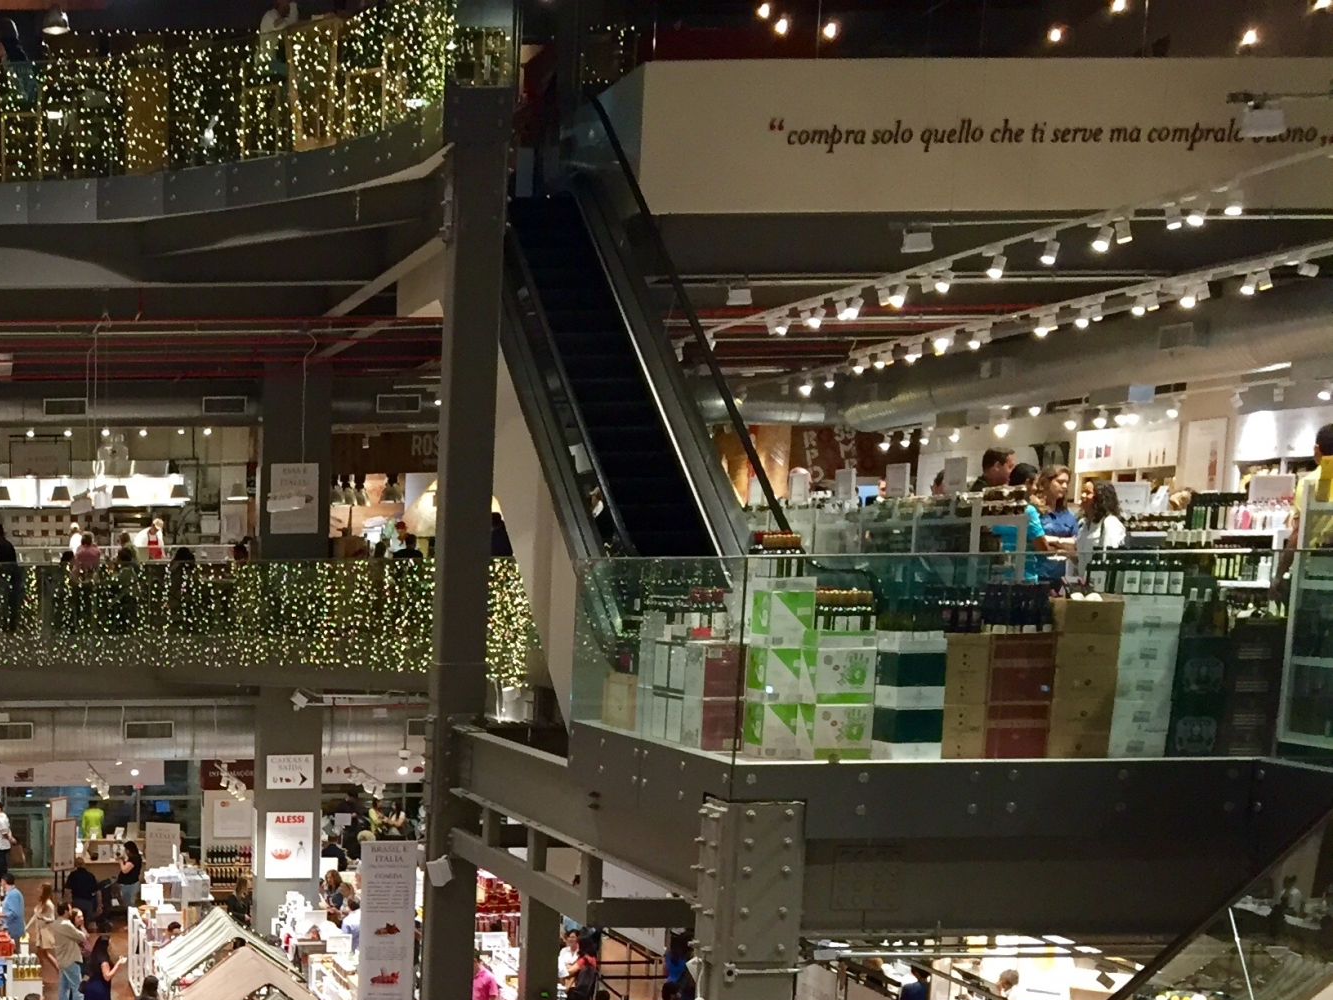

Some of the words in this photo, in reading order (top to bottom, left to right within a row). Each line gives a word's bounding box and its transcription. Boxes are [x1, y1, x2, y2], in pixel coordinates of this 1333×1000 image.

[870, 119, 914, 145] solo
[920, 118, 984, 153] quello
[989, 118, 1025, 144] che
[1031, 121, 1047, 144] ti
[1051, 123, 1103, 144] serve
[1109, 125, 1142, 143] ma
[275, 815, 305, 824] ALESSI
